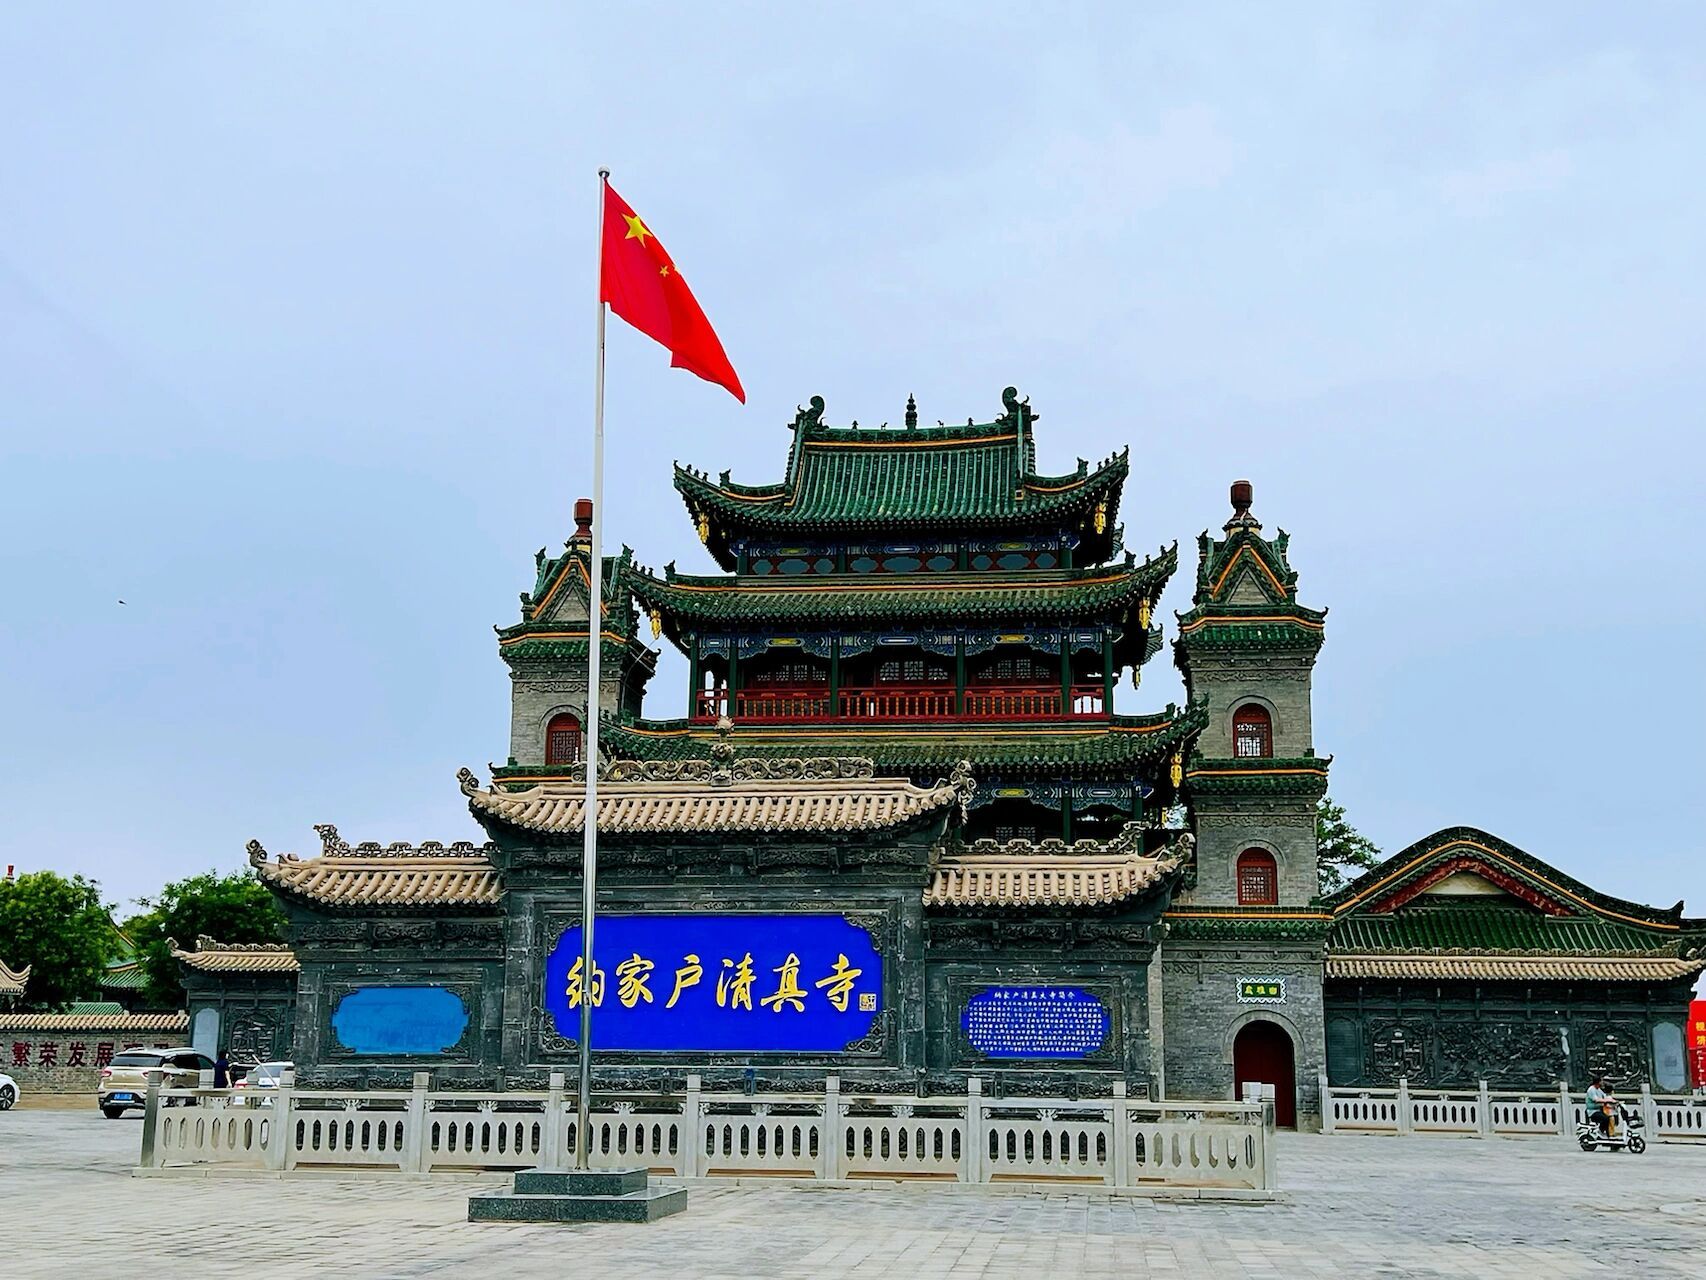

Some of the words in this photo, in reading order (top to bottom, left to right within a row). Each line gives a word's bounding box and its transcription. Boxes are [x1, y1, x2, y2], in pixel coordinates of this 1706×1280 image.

[564, 952, 863, 1013] 纳家户清真寺
[0, 1041, 170, 1067] 繁荣发展
